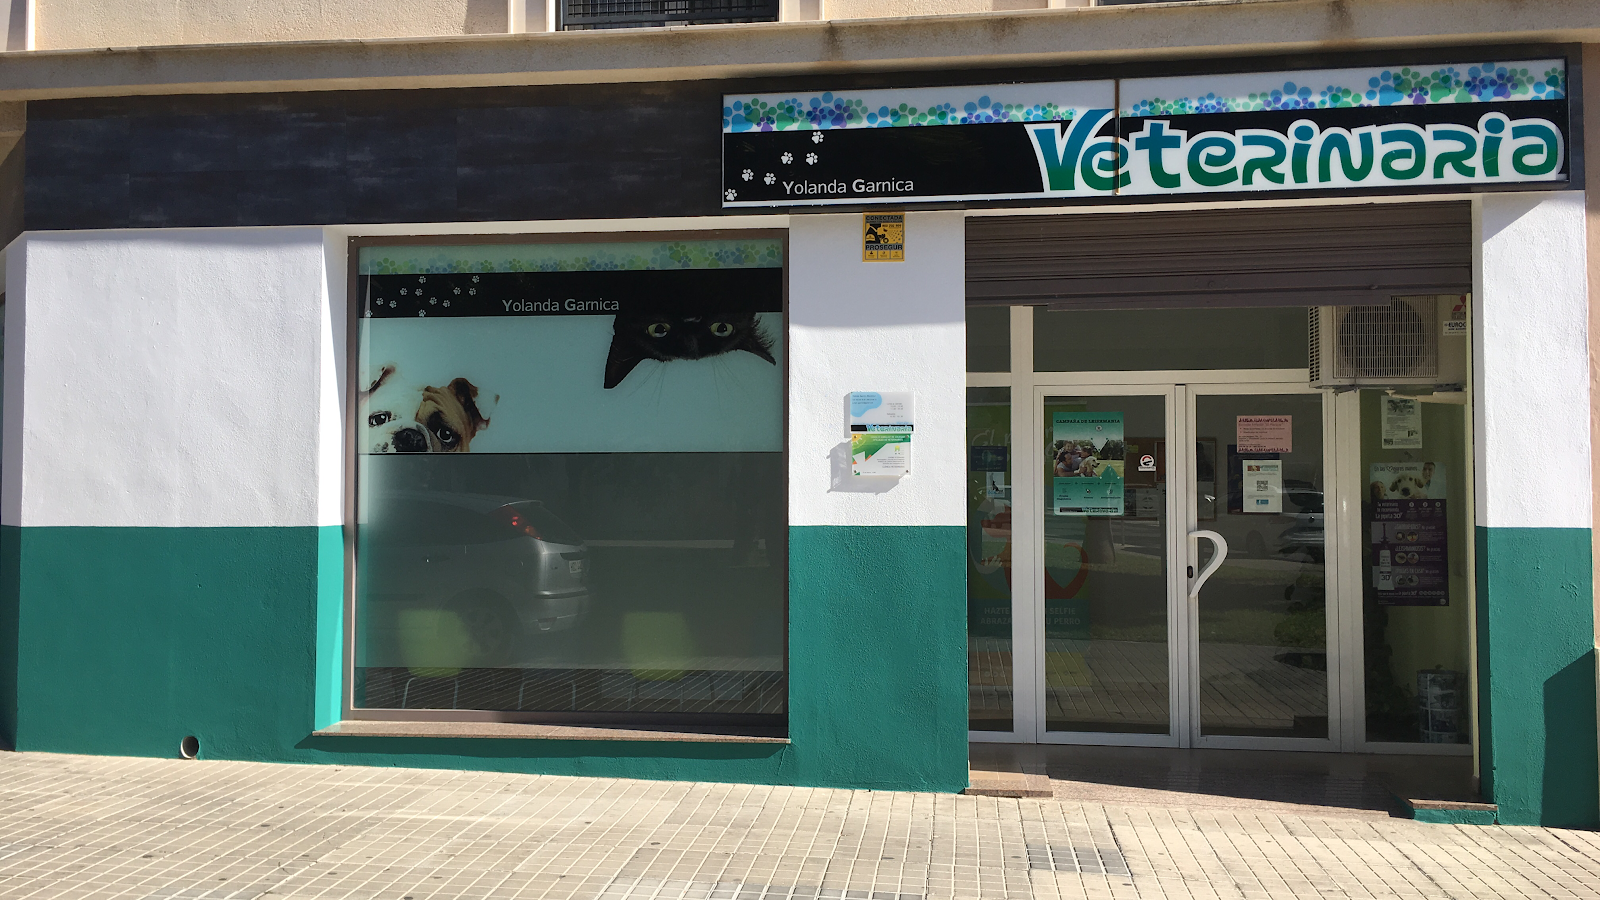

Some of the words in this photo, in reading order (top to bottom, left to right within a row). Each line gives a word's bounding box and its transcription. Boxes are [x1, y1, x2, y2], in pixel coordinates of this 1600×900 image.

[782, 179, 847, 195] Yolanda
[852, 177, 914, 193] Garnica
[501, 298, 560, 312] Yolanda
[564, 297, 620, 311] Garnica
[984, 607, 1010, 615] HAZTE
[1049, 607, 1076, 615] SELFIE
[1053, 617, 1081, 625] PERRO
